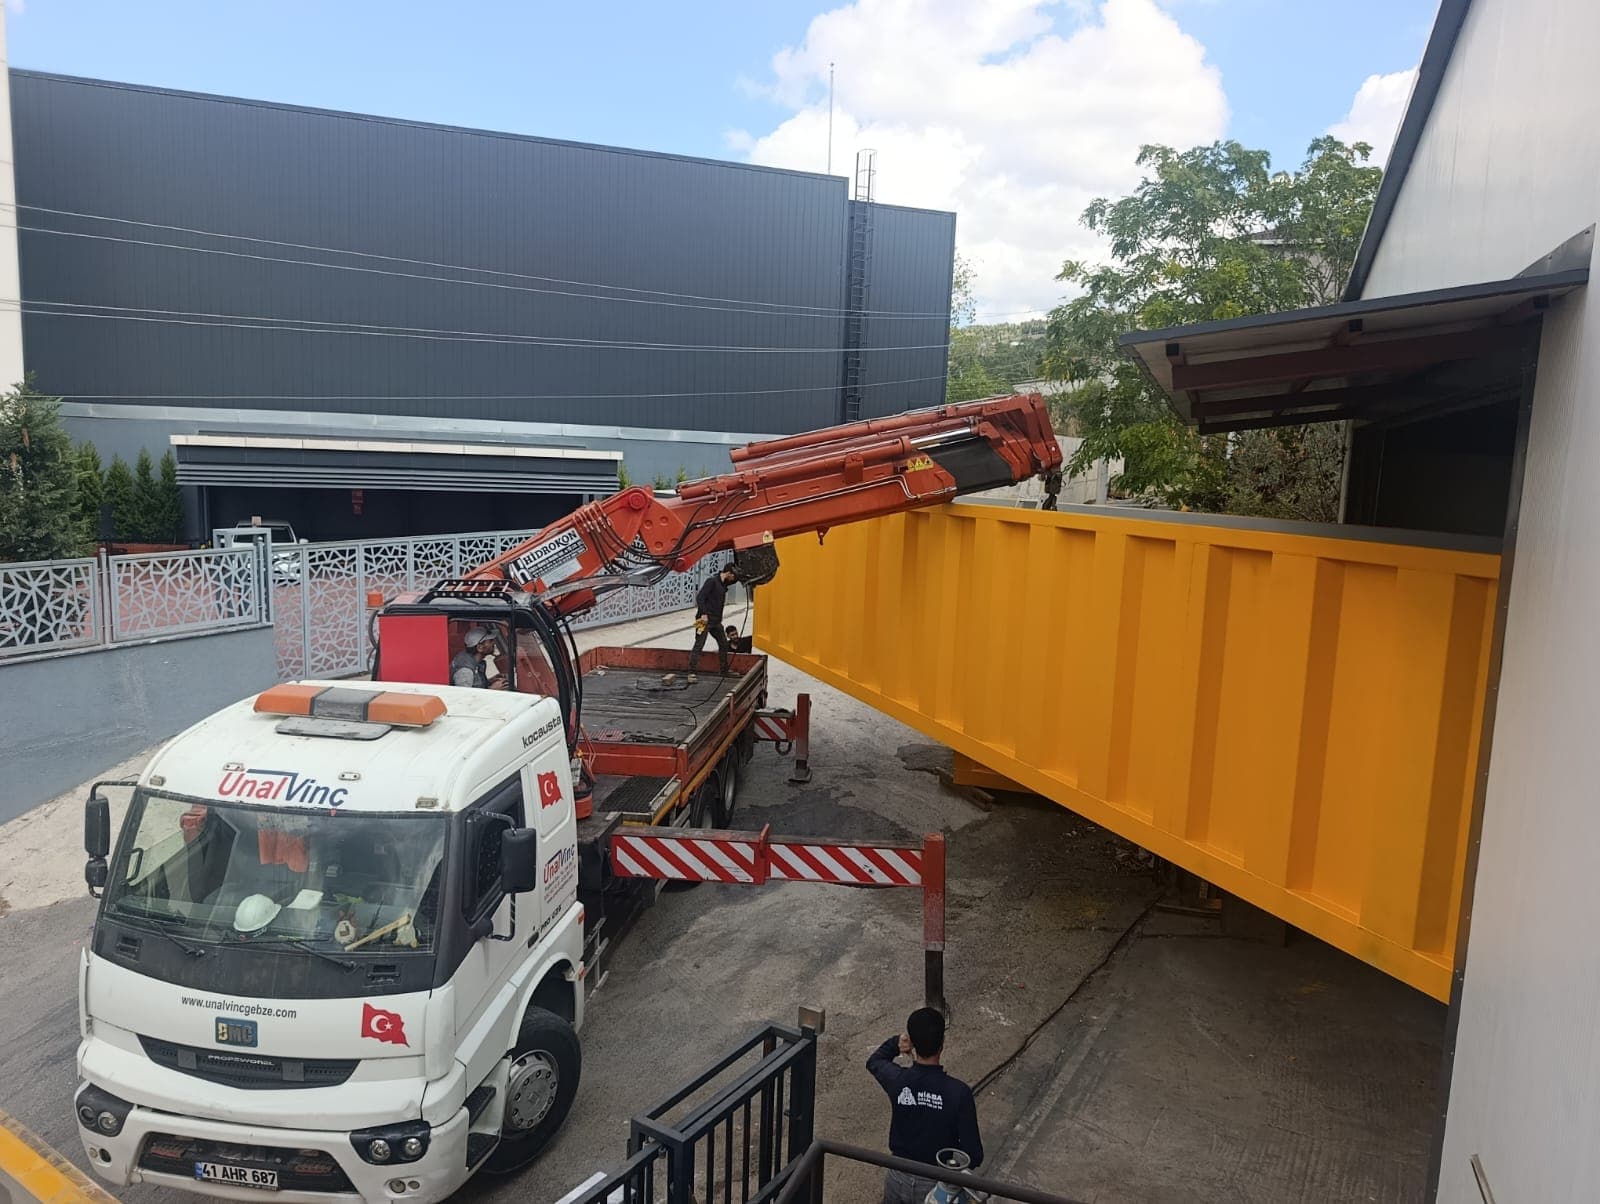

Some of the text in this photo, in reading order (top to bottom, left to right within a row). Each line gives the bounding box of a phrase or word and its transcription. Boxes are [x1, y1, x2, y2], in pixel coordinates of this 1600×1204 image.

[522, 715, 562, 749] kocausta
[181, 996, 297, 1019] www.unalvincgebze.com
[217, 1021, 253, 1045] BMC
[202, 1163, 276, 1185] 41 AHR 687
